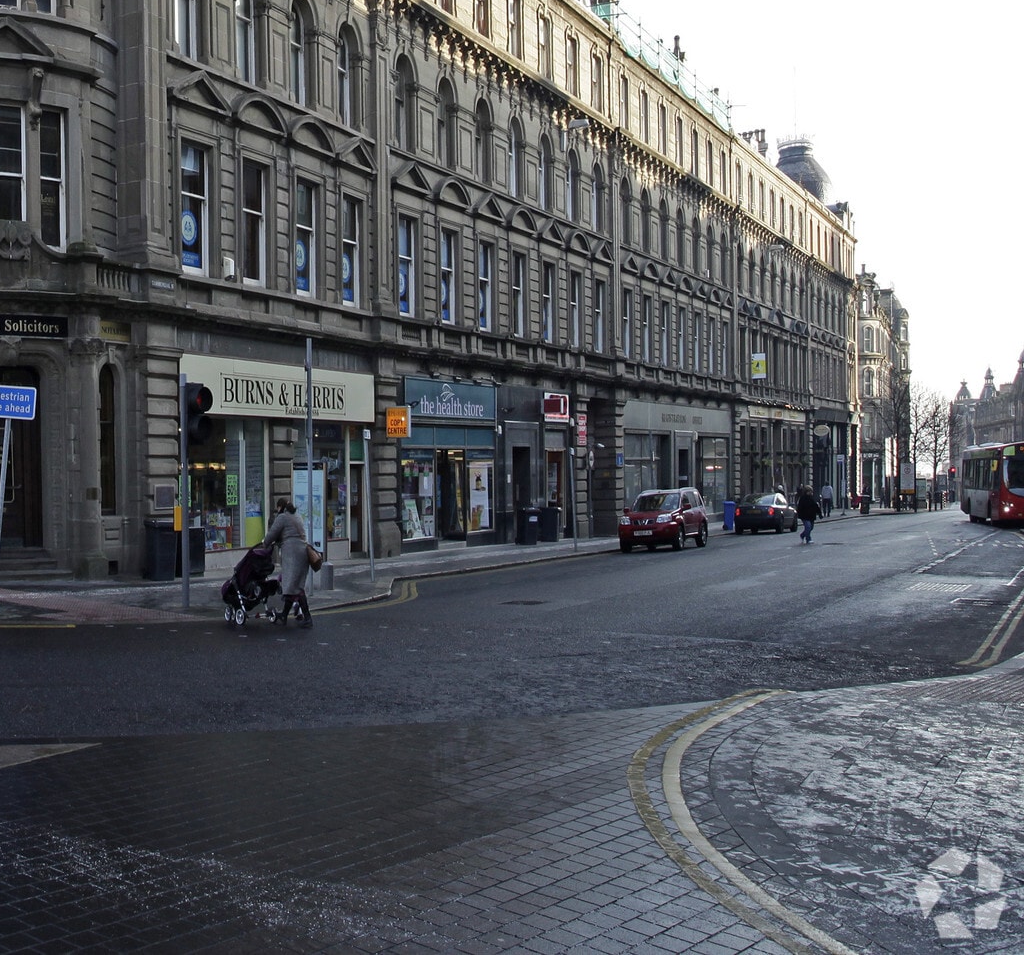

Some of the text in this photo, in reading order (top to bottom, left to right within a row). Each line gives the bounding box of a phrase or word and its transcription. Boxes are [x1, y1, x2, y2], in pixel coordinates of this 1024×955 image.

[4, 319, 60, 333] Solicitors
[223, 377, 274, 405] BURNS
[279, 382, 289, 406] &
[5, 403, 31, 413] ahead
[420, 395, 484, 417] the health store
[390, 418, 403, 427] COPY
[388, 427, 407, 435] CENTRE
